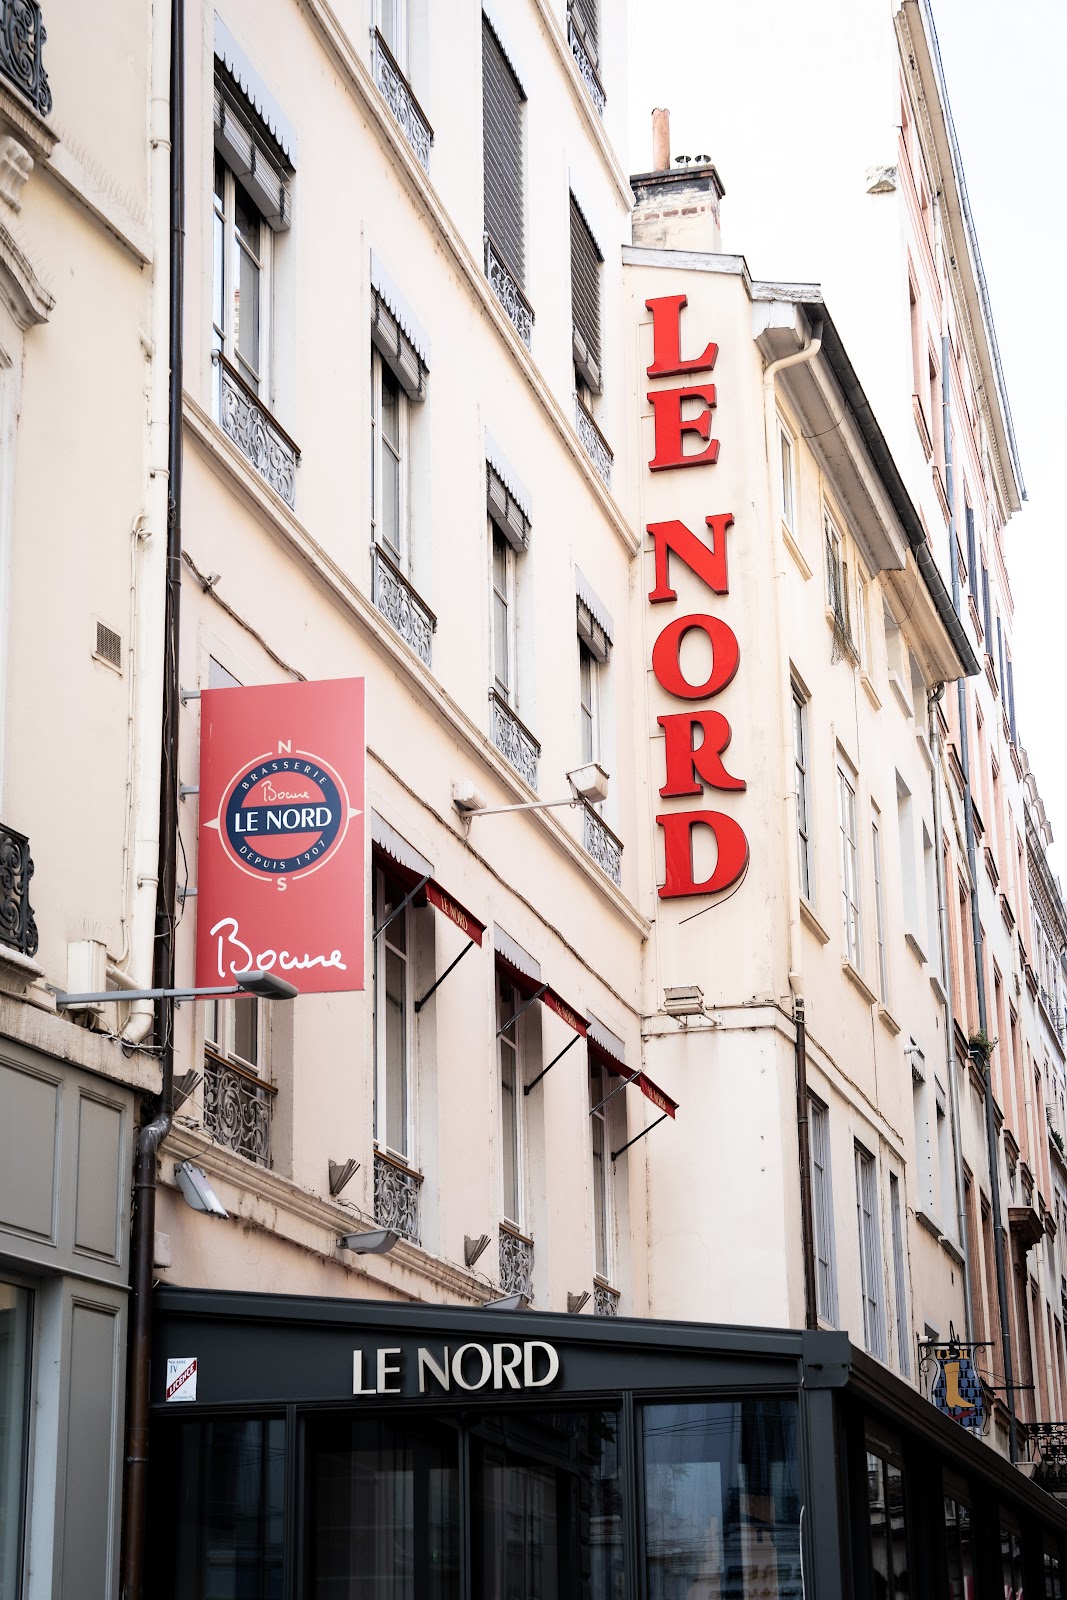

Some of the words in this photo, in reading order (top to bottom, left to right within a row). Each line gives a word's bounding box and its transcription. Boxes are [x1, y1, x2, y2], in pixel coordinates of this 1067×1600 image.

[645, 294, 719, 472] LE
[646, 513, 750, 900] NORD
[278, 740, 291, 754] N
[242, 762, 327, 790] BRASSERIE
[235, 812, 259, 833] LE
[266, 807, 332, 830] NORD
[240, 845, 286, 870] DEPUIS
[296, 840, 325, 865] 1907
[277, 877, 287, 891] S
[441, 895, 449, 915] LE
[449, 902, 468, 931] NORD
[169, 1363, 196, 1396] LICENCE
[353, 1348, 401, 1395] LE
[417, 1341, 560, 1393] NORD
